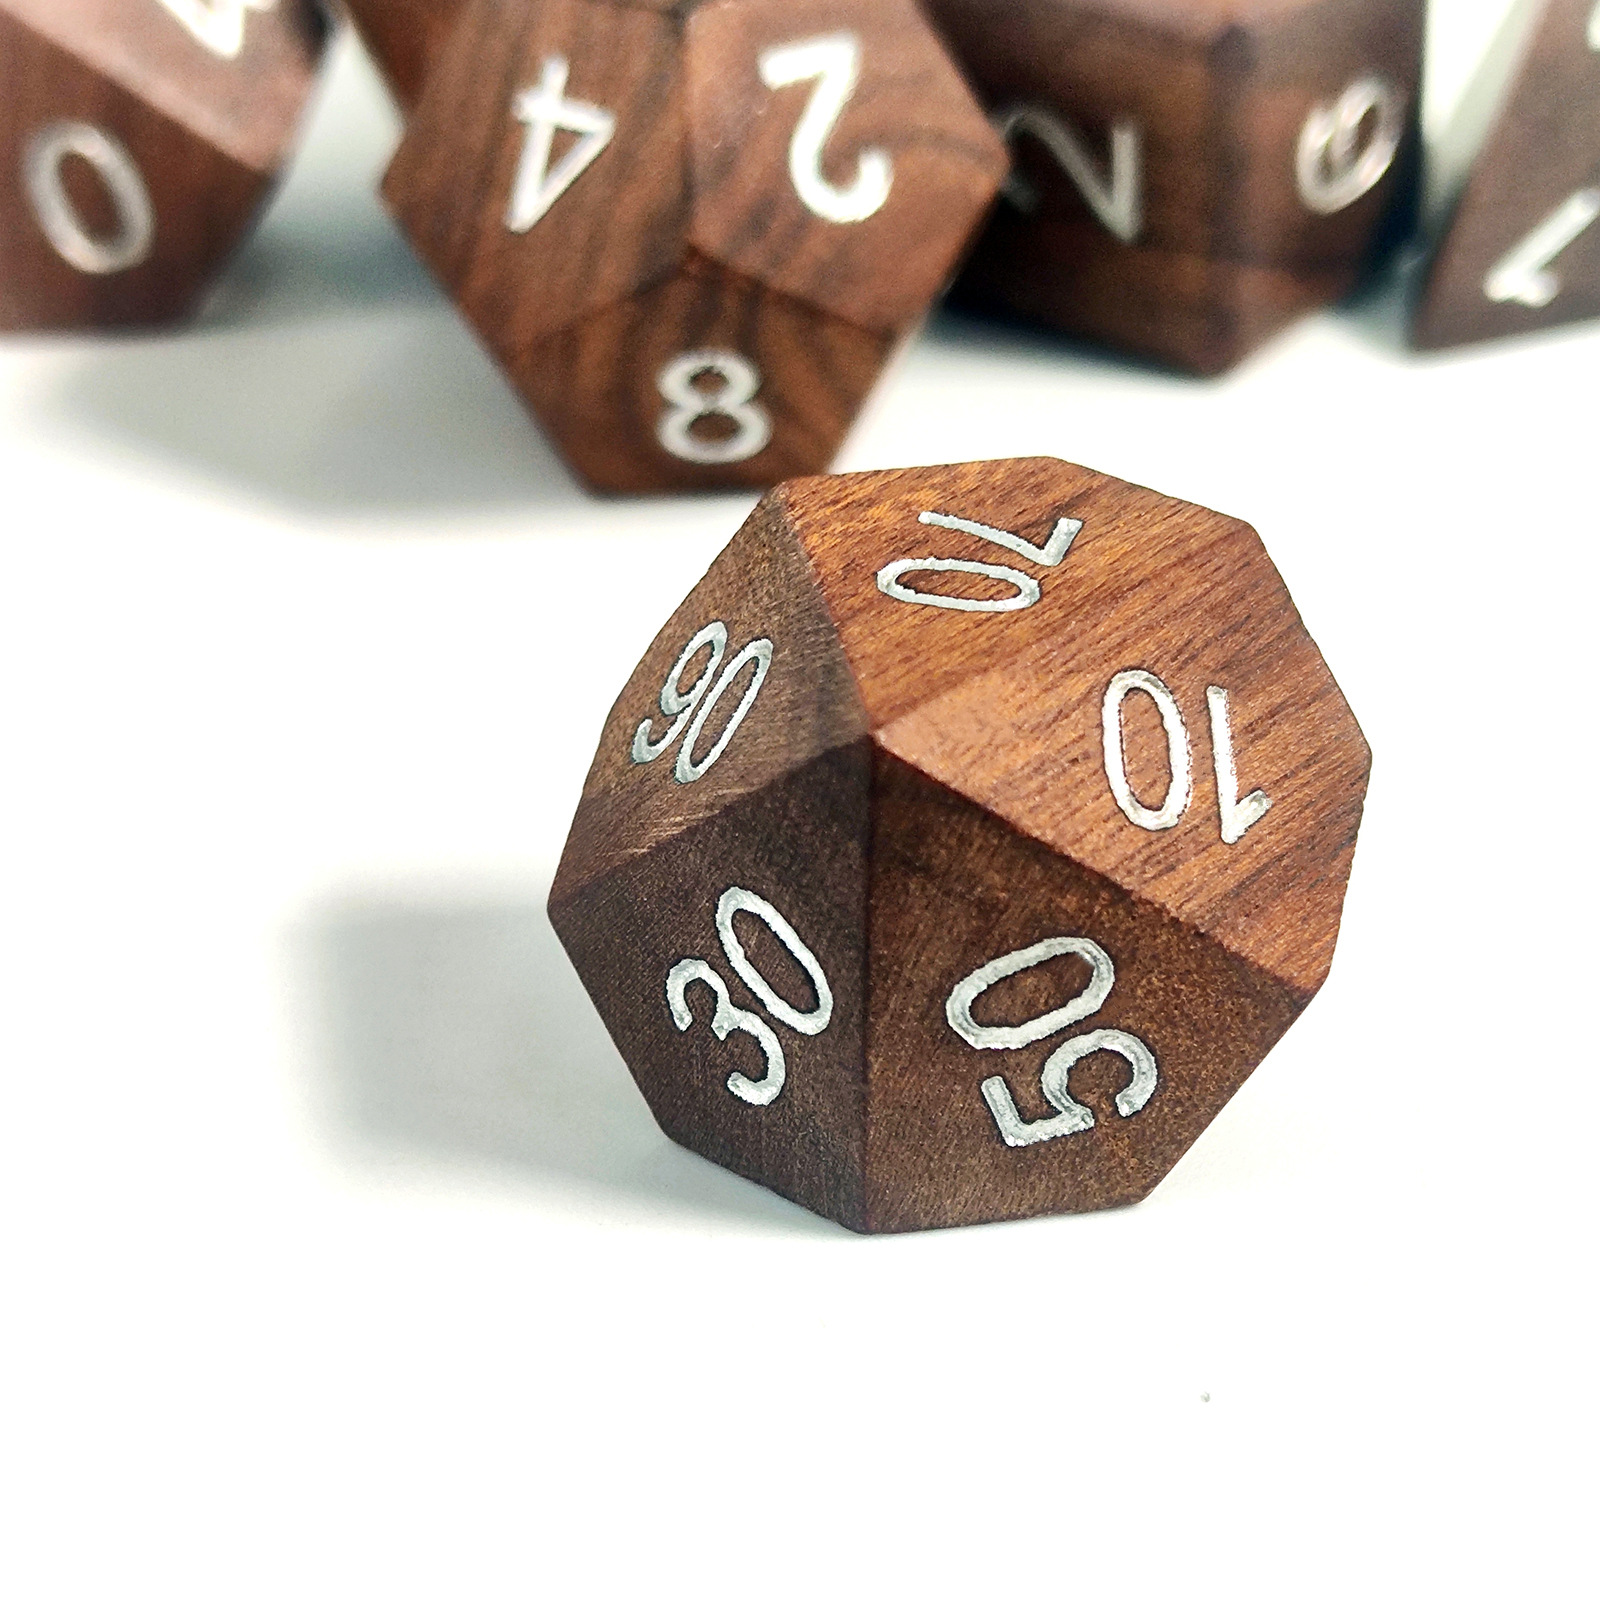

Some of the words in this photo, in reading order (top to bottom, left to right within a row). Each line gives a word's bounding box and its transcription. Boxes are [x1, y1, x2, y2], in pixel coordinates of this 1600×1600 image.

[23, 121, 155, 275] 0
[504, 56, 617, 233] 4
[760, 34, 894, 224] 2
[656, 348, 770, 463] 8
[876, 511, 1083, 614] 70
[631, 620, 773, 784] 90
[1103, 669, 1272, 845] 10
[665, 886, 834, 1107] 30
[946, 936, 1158, 1147] 50
